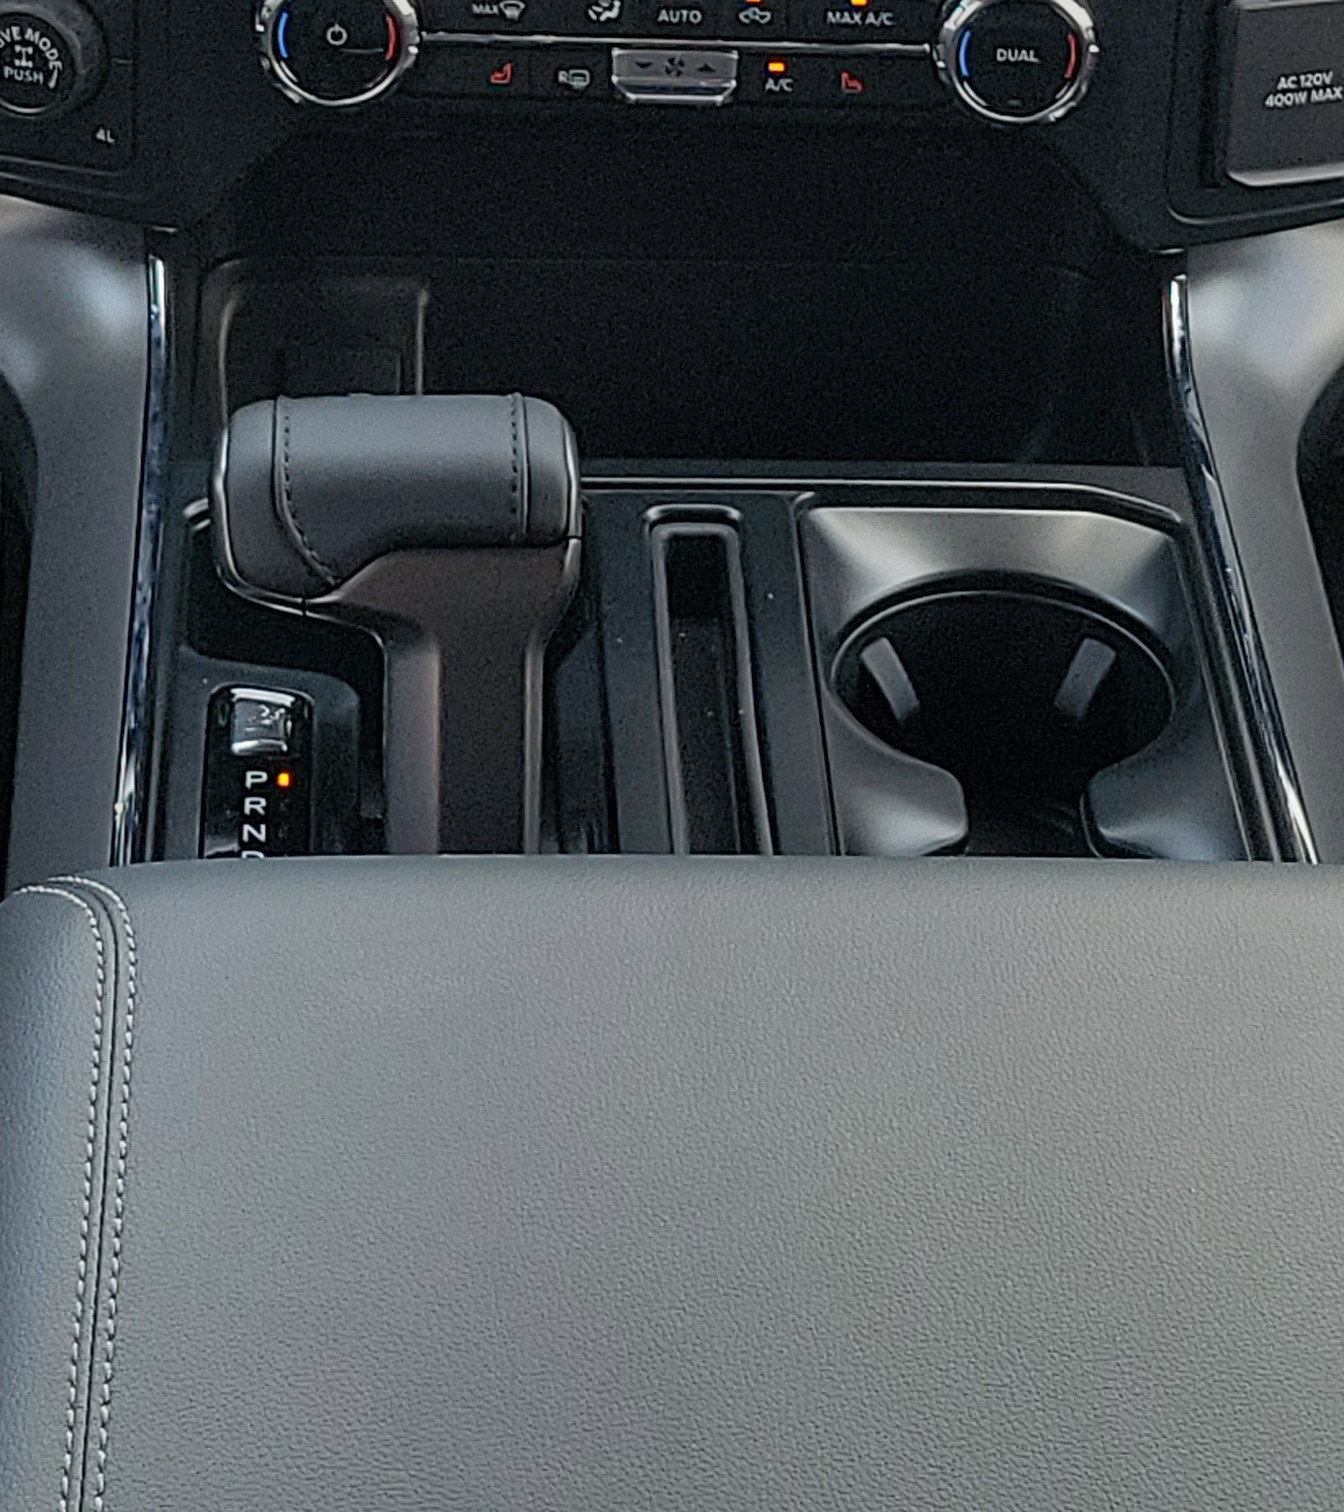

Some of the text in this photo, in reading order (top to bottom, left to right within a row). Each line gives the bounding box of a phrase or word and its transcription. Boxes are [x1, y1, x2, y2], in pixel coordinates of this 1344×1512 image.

[472, 3, 499, 15] MAX
[657, 9, 702, 24] AUTO
[826, 11, 895, 27] MAX A/C
[23, 28, 63, 71] MODE
[996, 48, 1039, 63] DUAL
[3, 68, 44, 84] PUSH
[1277, 72, 1334, 90] AC 120V
[765, 77, 794, 92] A/C
[1265, 88, 1344, 108] 400W MAX
[95, 128, 116, 143] 4L
[245, 770, 268, 790] P
[244, 796, 267, 816] R
[242, 824, 266, 843] N
